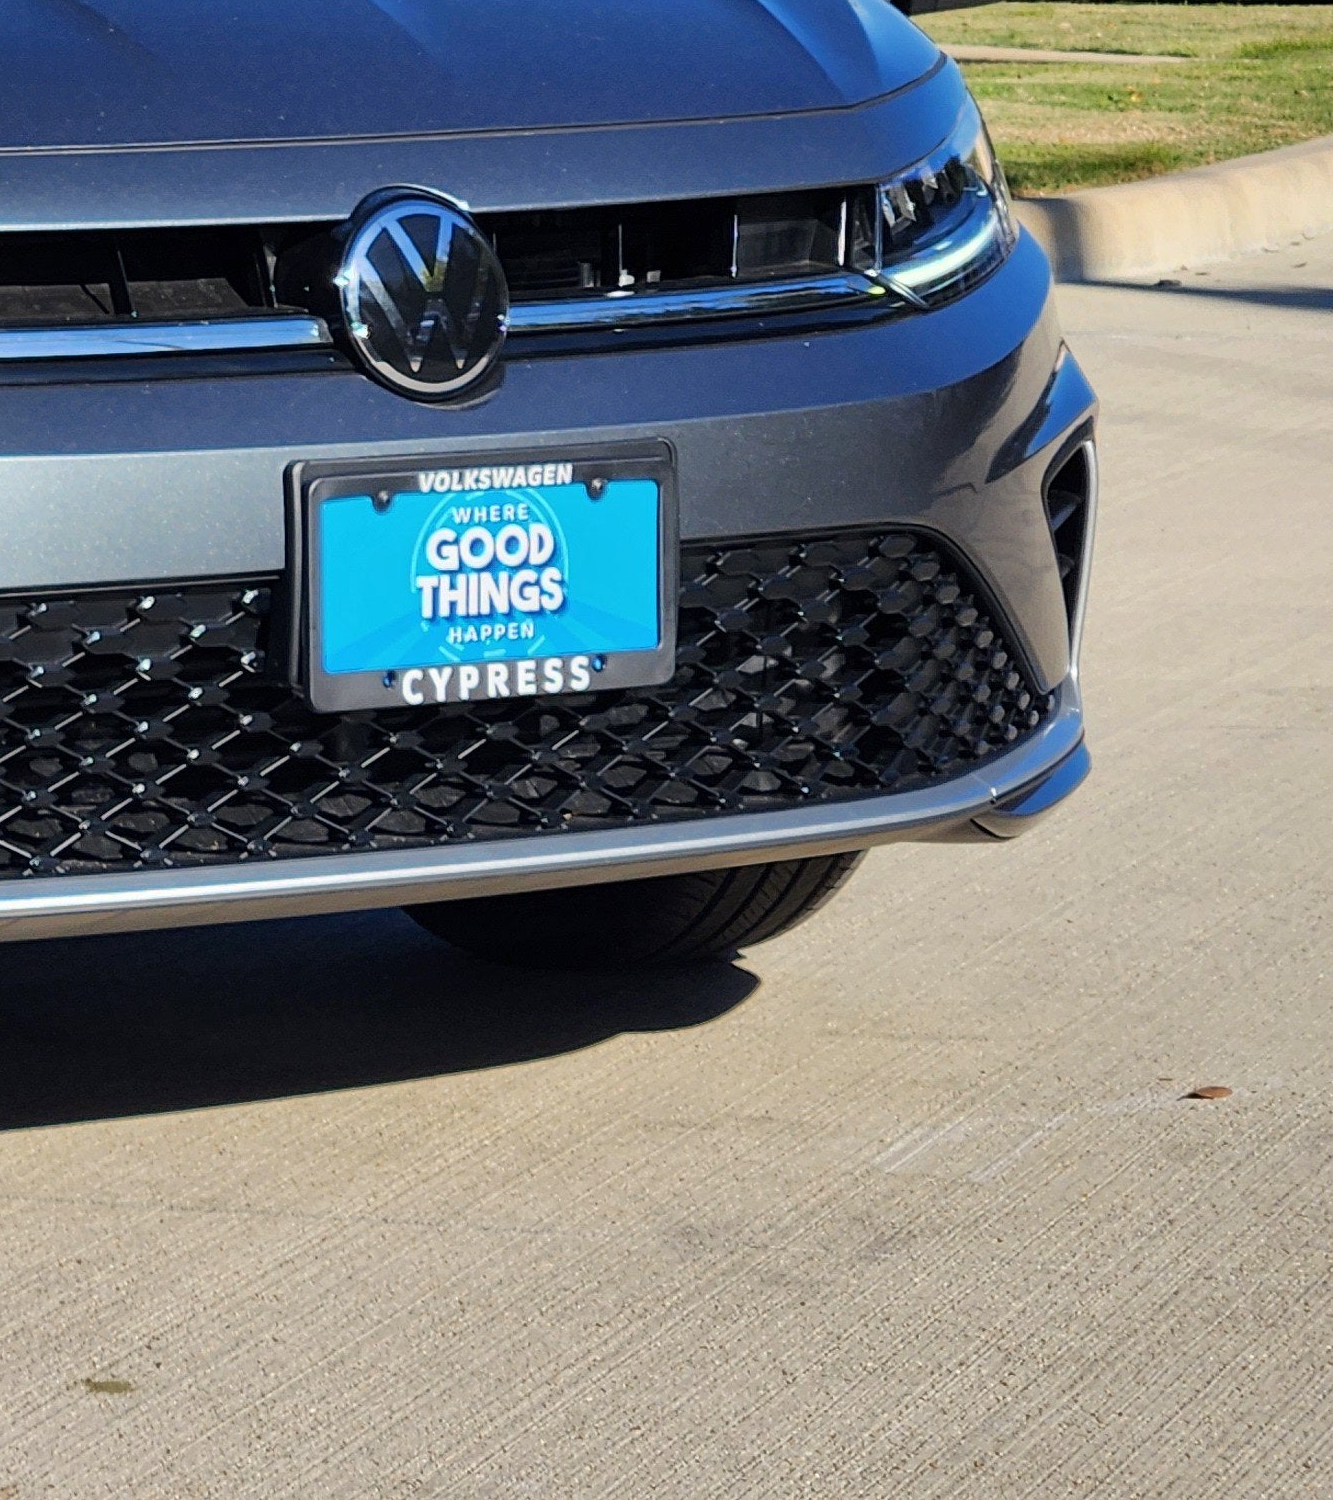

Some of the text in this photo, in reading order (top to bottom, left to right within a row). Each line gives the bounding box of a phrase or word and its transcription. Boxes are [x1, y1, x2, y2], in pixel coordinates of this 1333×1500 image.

[418, 463, 573, 493] VOLKSWAGEN
[452, 503, 529, 524] WHERE
[426, 522, 554, 570] GOOD
[415, 567, 564, 619] THINGS
[449, 619, 534, 643] HAPPEN
[402, 655, 590, 705] CYPRESS
